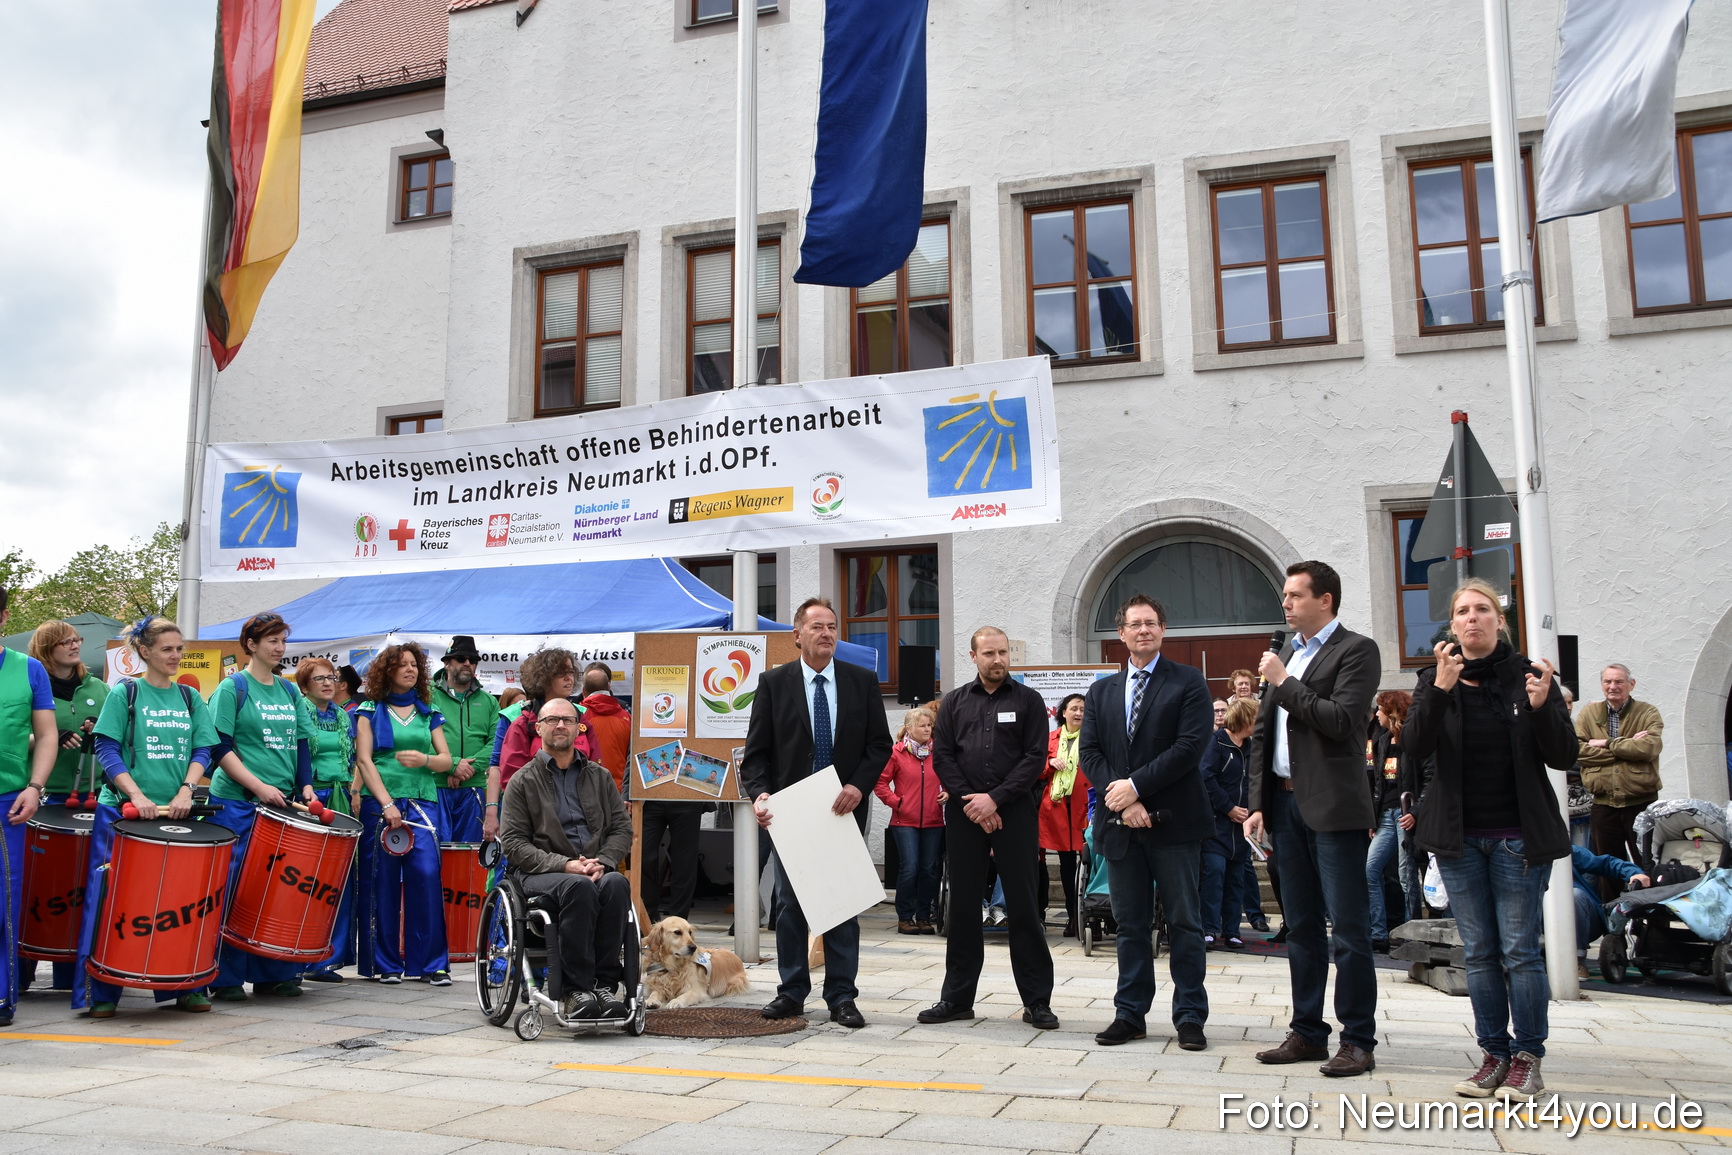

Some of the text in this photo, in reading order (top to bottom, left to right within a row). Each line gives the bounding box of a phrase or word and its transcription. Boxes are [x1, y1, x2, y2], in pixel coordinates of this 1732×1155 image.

[331, 403, 882, 481] Arbeitsgemeinschaft offene Behindertenarbeit
[413, 445, 777, 506] im Landkreis Neumarkt i.d.OPf.
[574, 502, 619, 515] Diakonie
[692, 494, 784, 516] Regens Wagner
[423, 516, 483, 530] Bayerisches
[511, 512, 542, 522] Caritas-
[574, 509, 659, 528] Nürnberger Land
[421, 529, 451, 539] Rotes
[509, 522, 560, 534] Sozialstation
[507, 533, 564, 546] Neumarkt e.V.
[572, 528, 622, 541] Neumarkt
[420, 540, 449, 550] Kreuz
[703, 639, 762, 656] SYMPATHIEBLUME
[646, 667, 685, 675] URKUNDE
[261, 712, 295, 722] Fanshop
[146, 719, 190, 731] Fanshop
[146, 735, 159, 743] CD
[146, 743, 173, 751] Button
[147, 752, 175, 760] Shaker
